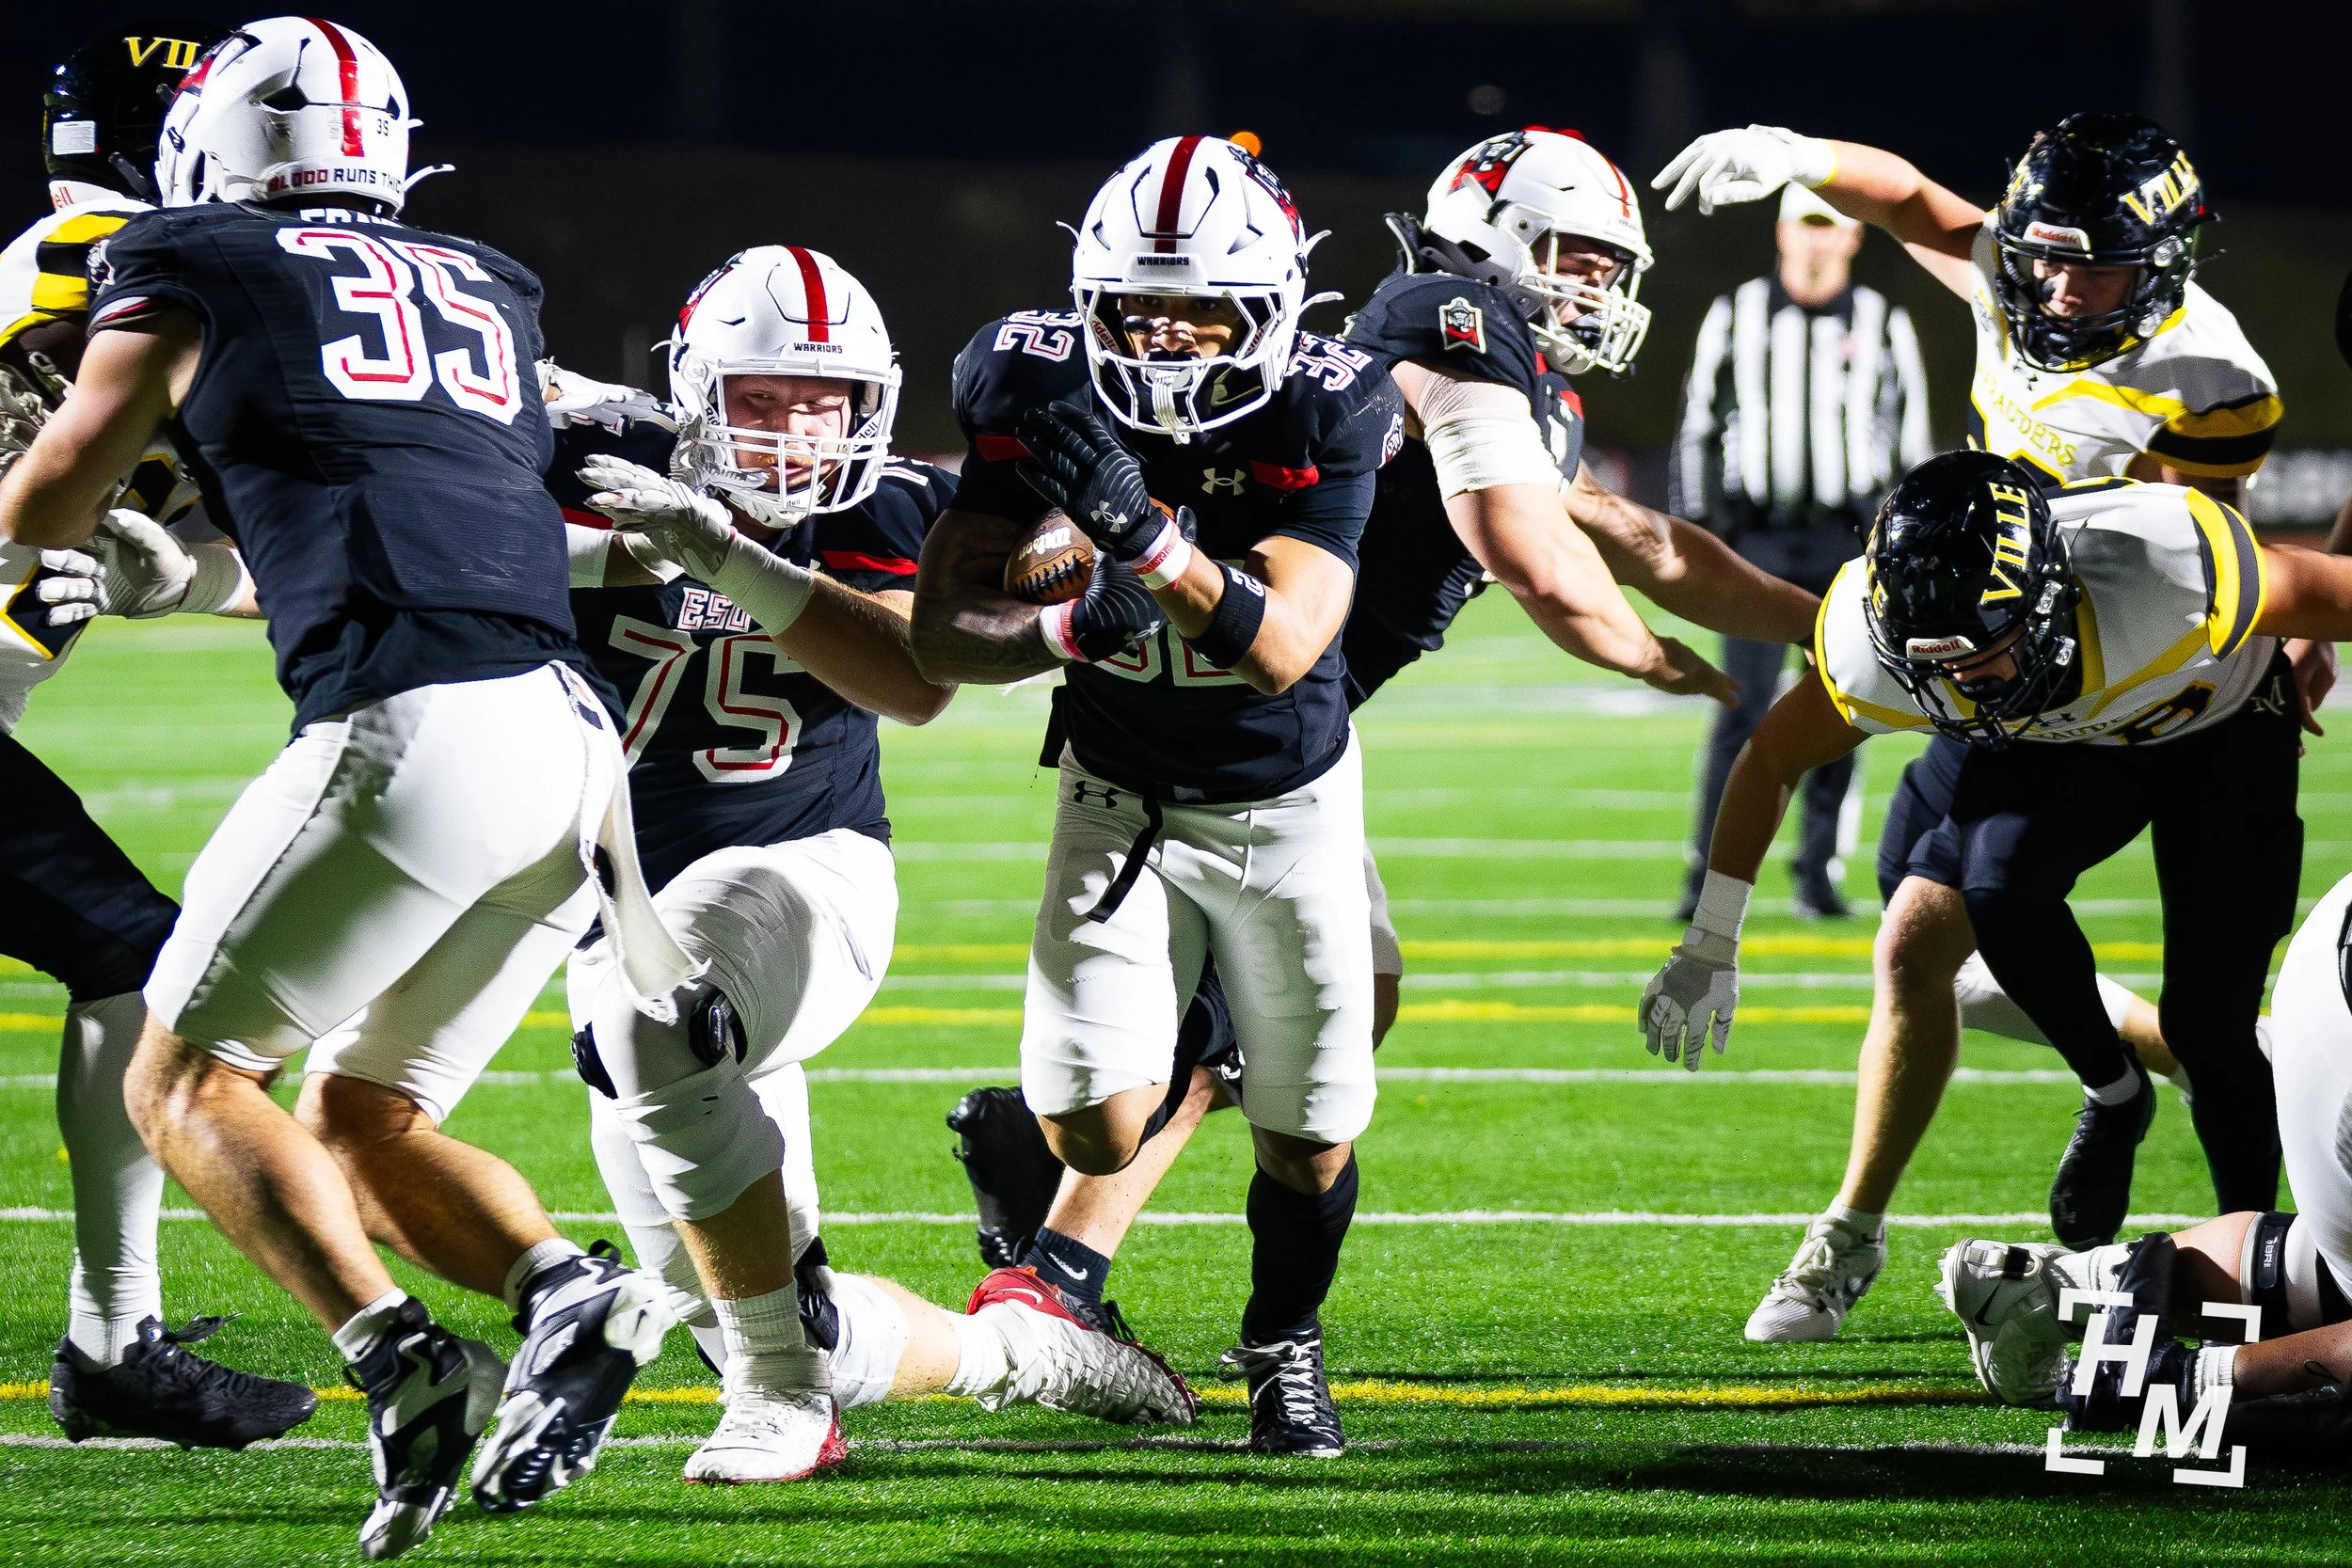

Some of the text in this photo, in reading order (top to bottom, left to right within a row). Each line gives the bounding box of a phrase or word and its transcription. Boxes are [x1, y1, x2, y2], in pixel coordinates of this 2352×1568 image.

[376, 119, 389, 136] 35
[266, 167, 404, 195] BLOOD RUNS THIC
[1136, 256, 1190, 266] WARRIORS
[276, 228, 522, 426] 35
[993, 309, 1081, 363] 32
[793, 342, 843, 355] WARRIORS
[1979, 482, 2030, 606] VILLE
[677, 587, 752, 633] ESU
[1910, 638, 1961, 654] Riddell
[608, 613, 803, 784] 75
